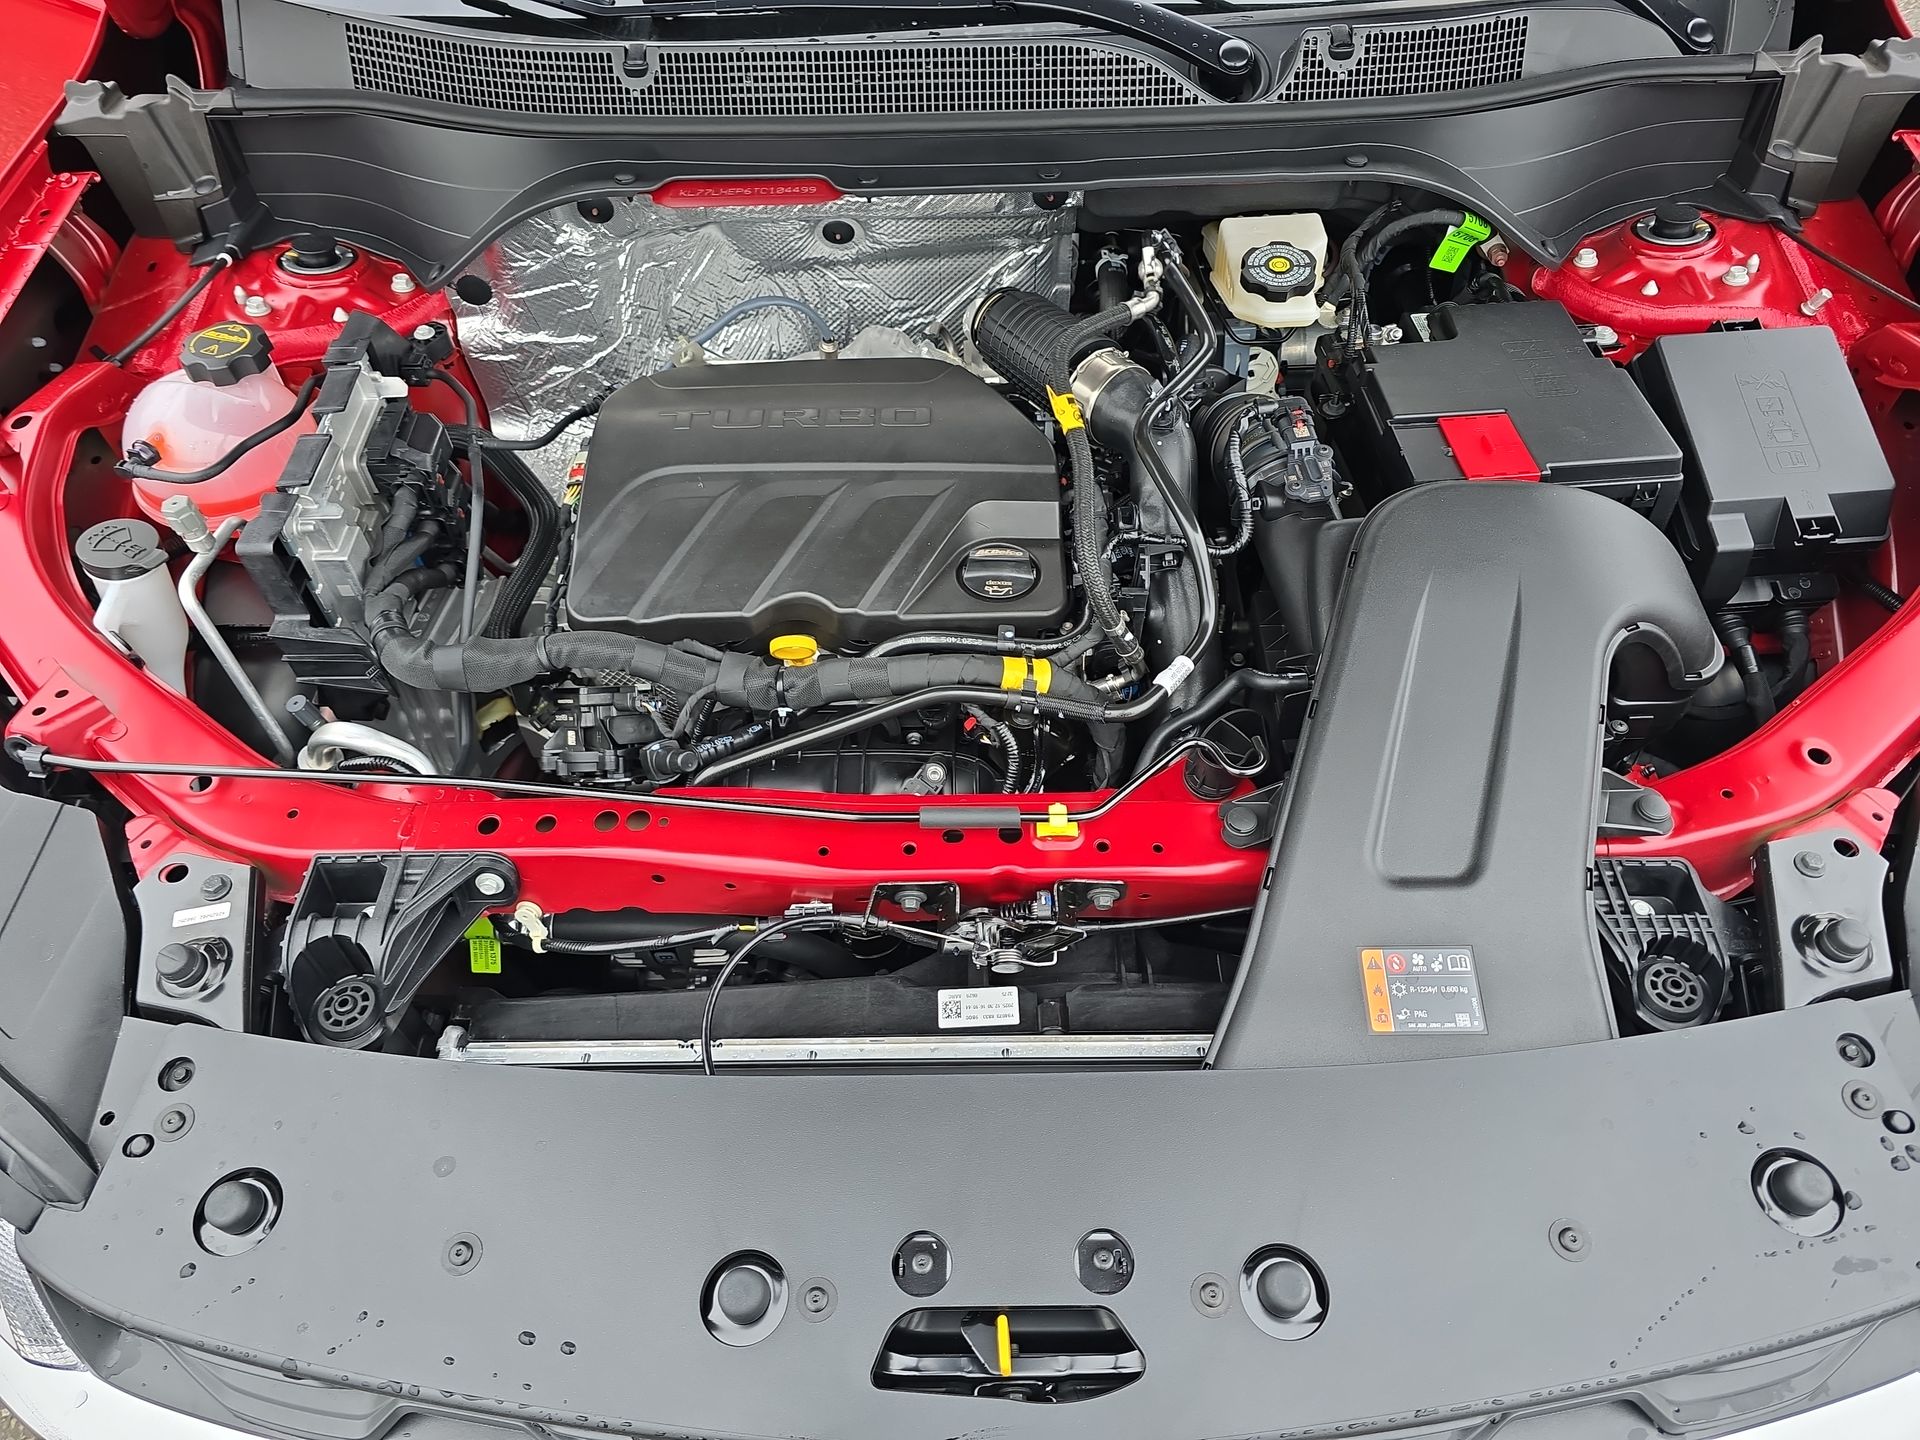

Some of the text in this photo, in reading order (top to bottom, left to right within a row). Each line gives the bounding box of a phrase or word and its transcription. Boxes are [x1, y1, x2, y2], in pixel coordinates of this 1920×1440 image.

[679, 186, 817, 197] KL77LHEP6TC104499
[658, 407, 932, 430] TURBO
[1409, 986, 1438, 995] R-1234yf
[1459, 986, 1468, 994] kg
[1414, 1010, 1428, 1018] PAG
